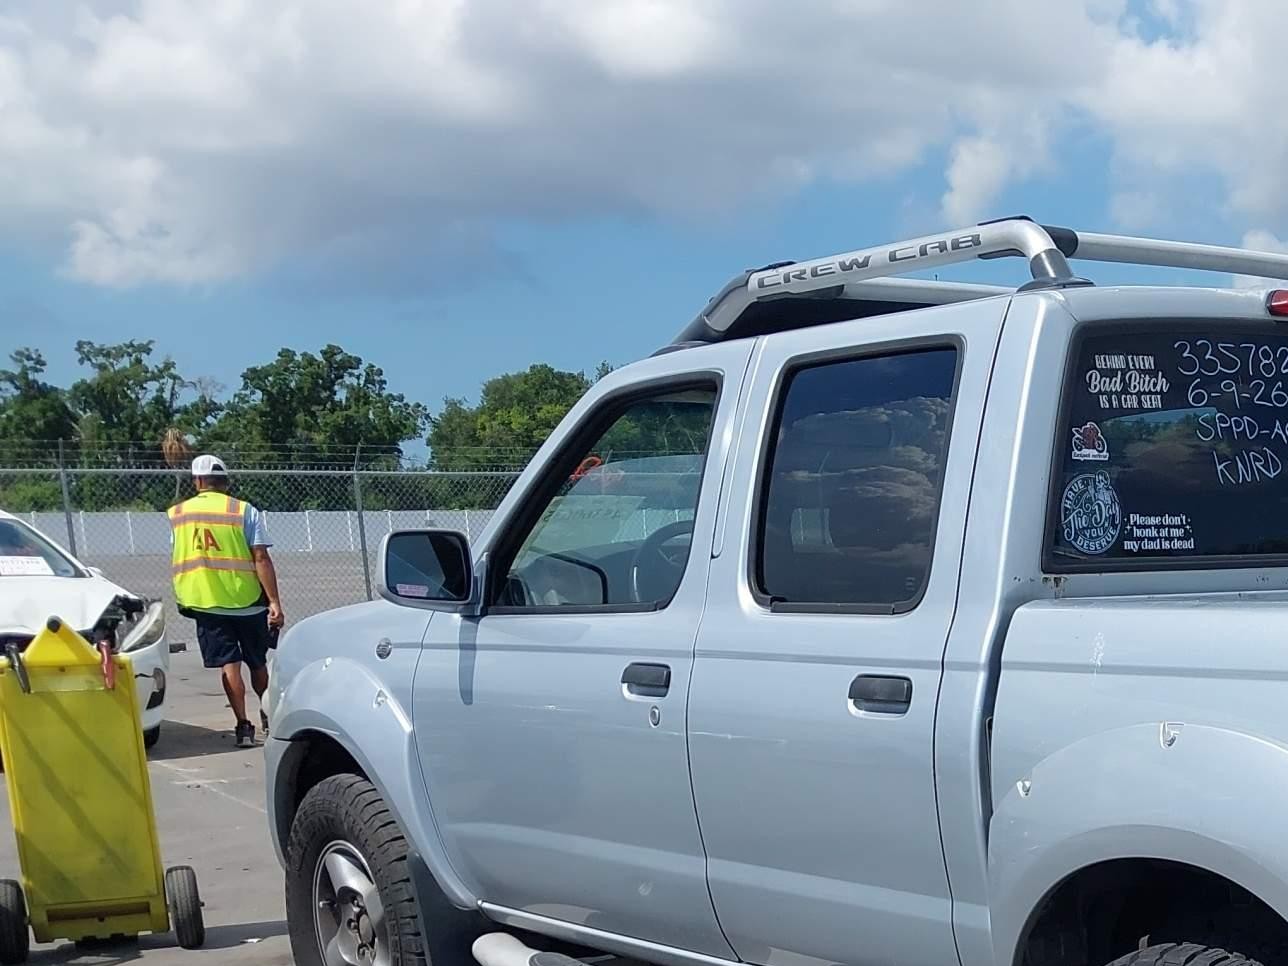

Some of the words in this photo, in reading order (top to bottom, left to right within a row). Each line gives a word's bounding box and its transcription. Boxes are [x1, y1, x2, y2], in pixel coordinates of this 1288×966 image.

[757, 255, 872, 288] CREW
[889, 233, 981, 262] CAB
[1095, 354, 1126, 369] BEHIND
[1128, 355, 1155, 369] EVERY
[1086, 369, 1124, 393] Bad
[1125, 370, 1170, 393] Bitch
[1099, 394, 1109, 408] IS
[1111, 394, 1119, 408] A
[1121, 394, 1140, 408] CAR
[1141, 394, 1162, 408] SEAT
[1188, 378, 1288, 409] 6-9-26
[1064, 479, 1085, 509] HAVE
[1092, 500, 1119, 528] Day
[1130, 513, 1161, 526] Please
[1162, 513, 1186, 526] don't
[1077, 527, 1116, 551] DESERVE
[1085, 526, 1104, 538] YOU
[1133, 525, 1158, 538] honk
[1159, 527, 1169, 537] at
[1170, 528, 1185, 537] me
[1124, 540, 1140, 552] my
[1141, 537, 1160, 550] dad
[1161, 538, 1170, 550] is
[1171, 537, 1194, 550] dead
